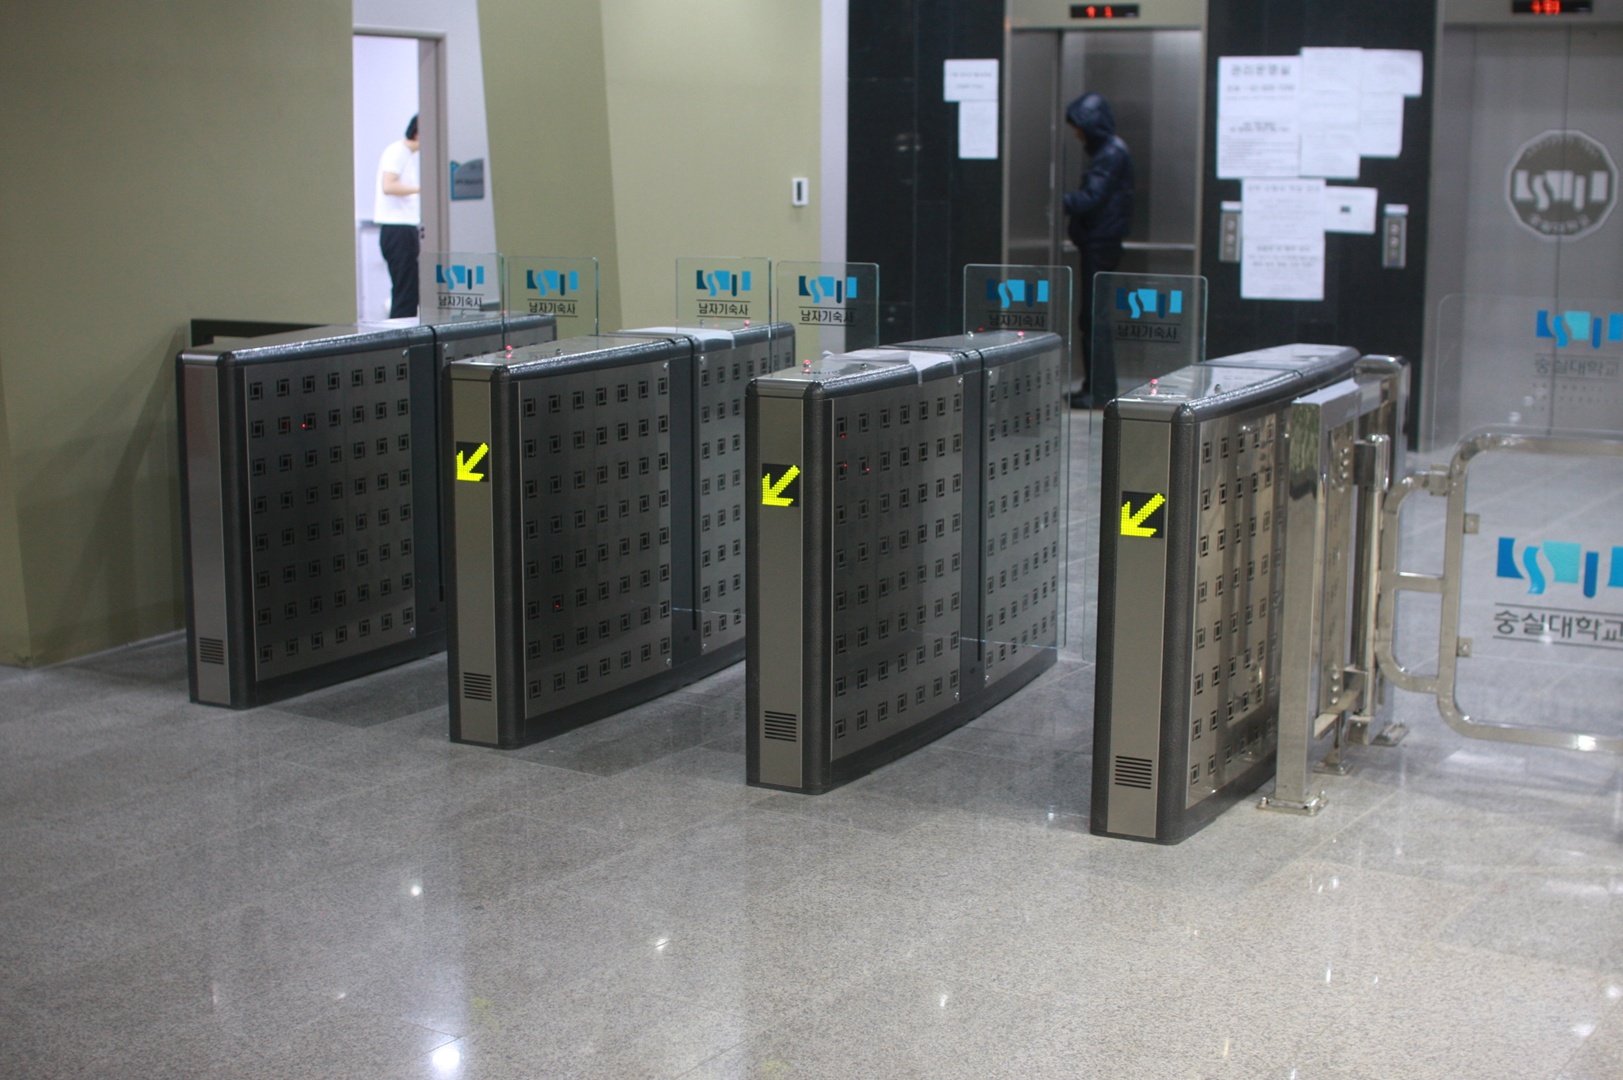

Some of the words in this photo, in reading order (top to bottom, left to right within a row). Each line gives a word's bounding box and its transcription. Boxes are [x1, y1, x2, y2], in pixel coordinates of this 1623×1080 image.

[438, 295, 483, 308] 남자기숙사
[529, 302, 576, 314] 남자기숙사
[699, 303, 749, 316] 남자기숙사
[801, 310, 854, 323] 남자기숙사
[989, 313, 1045, 328] 남자기숙사
[1117, 324, 1178, 340] 남자기숙사
[1493, 610, 1623, 641] 숭실대학교
